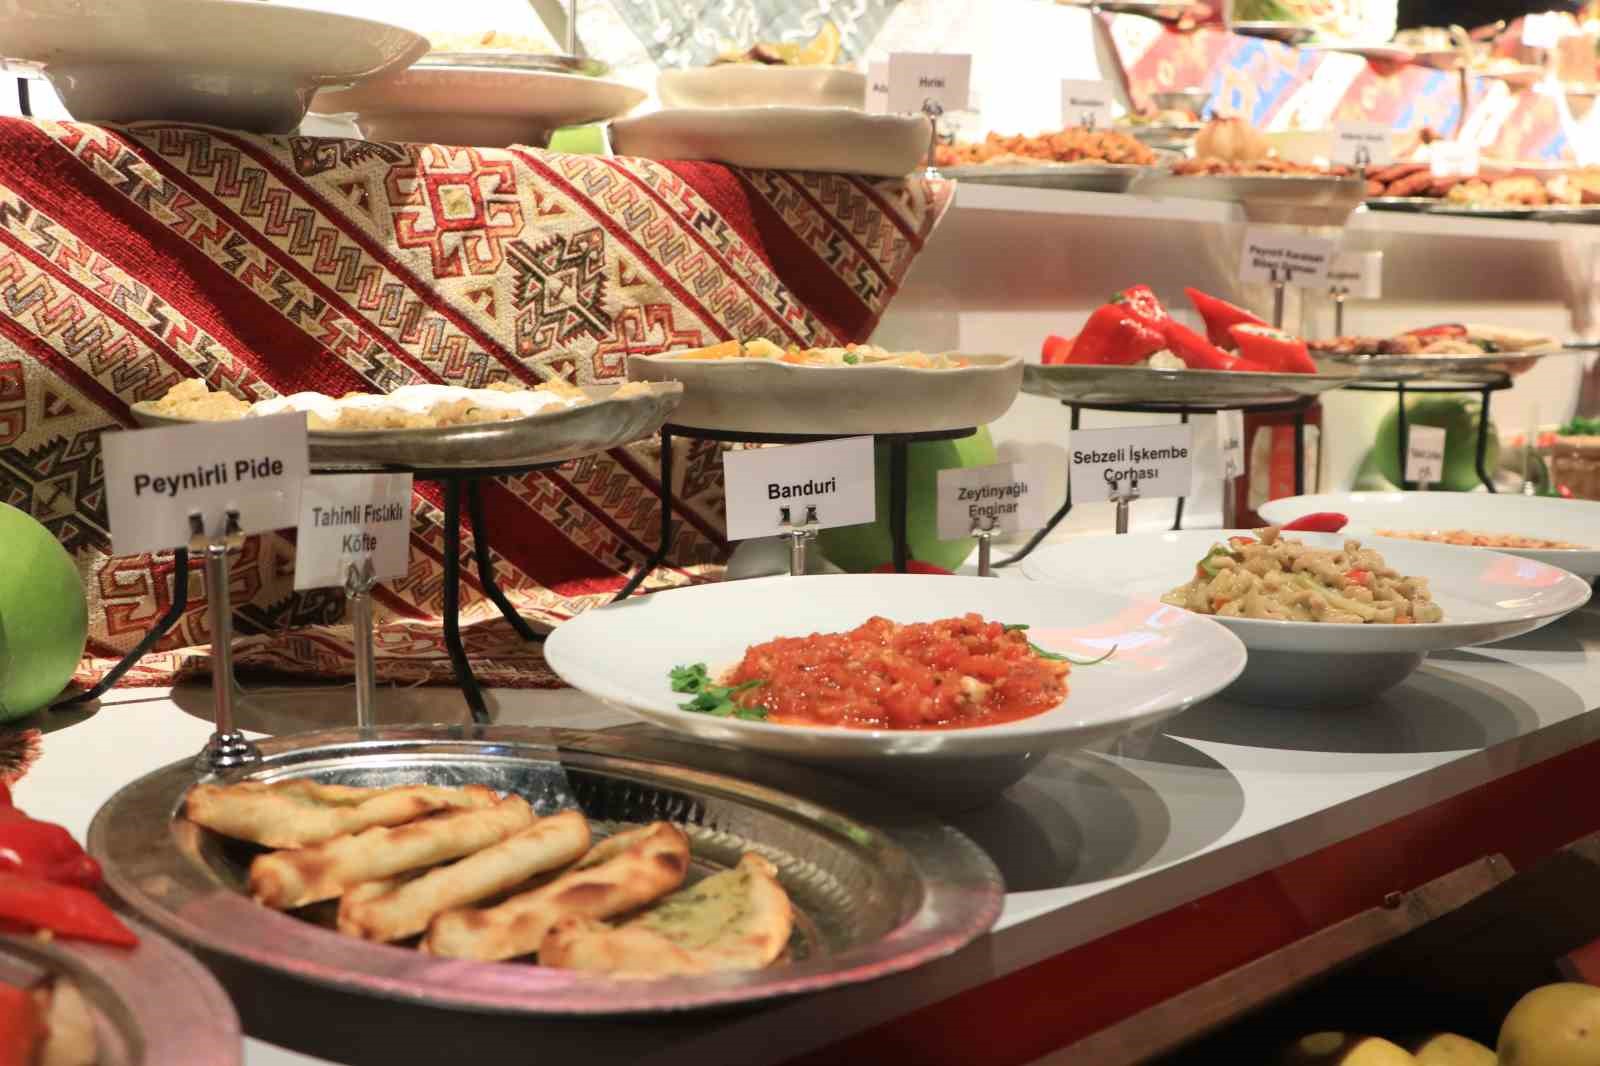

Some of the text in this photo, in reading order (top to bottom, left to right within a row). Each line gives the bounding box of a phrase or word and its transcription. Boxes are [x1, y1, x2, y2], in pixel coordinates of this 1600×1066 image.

[1073, 445, 1189, 464] Sebzeli İşkembe
[134, 456, 283, 497] Peynirli Pide
[768, 477, 836, 500] Banduri
[957, 481, 1028, 501] Zeytinyağlı
[312, 504, 361, 527] Tahinli
[969, 501, 1019, 518] Enginar
[342, 533, 377, 553] Köfte
